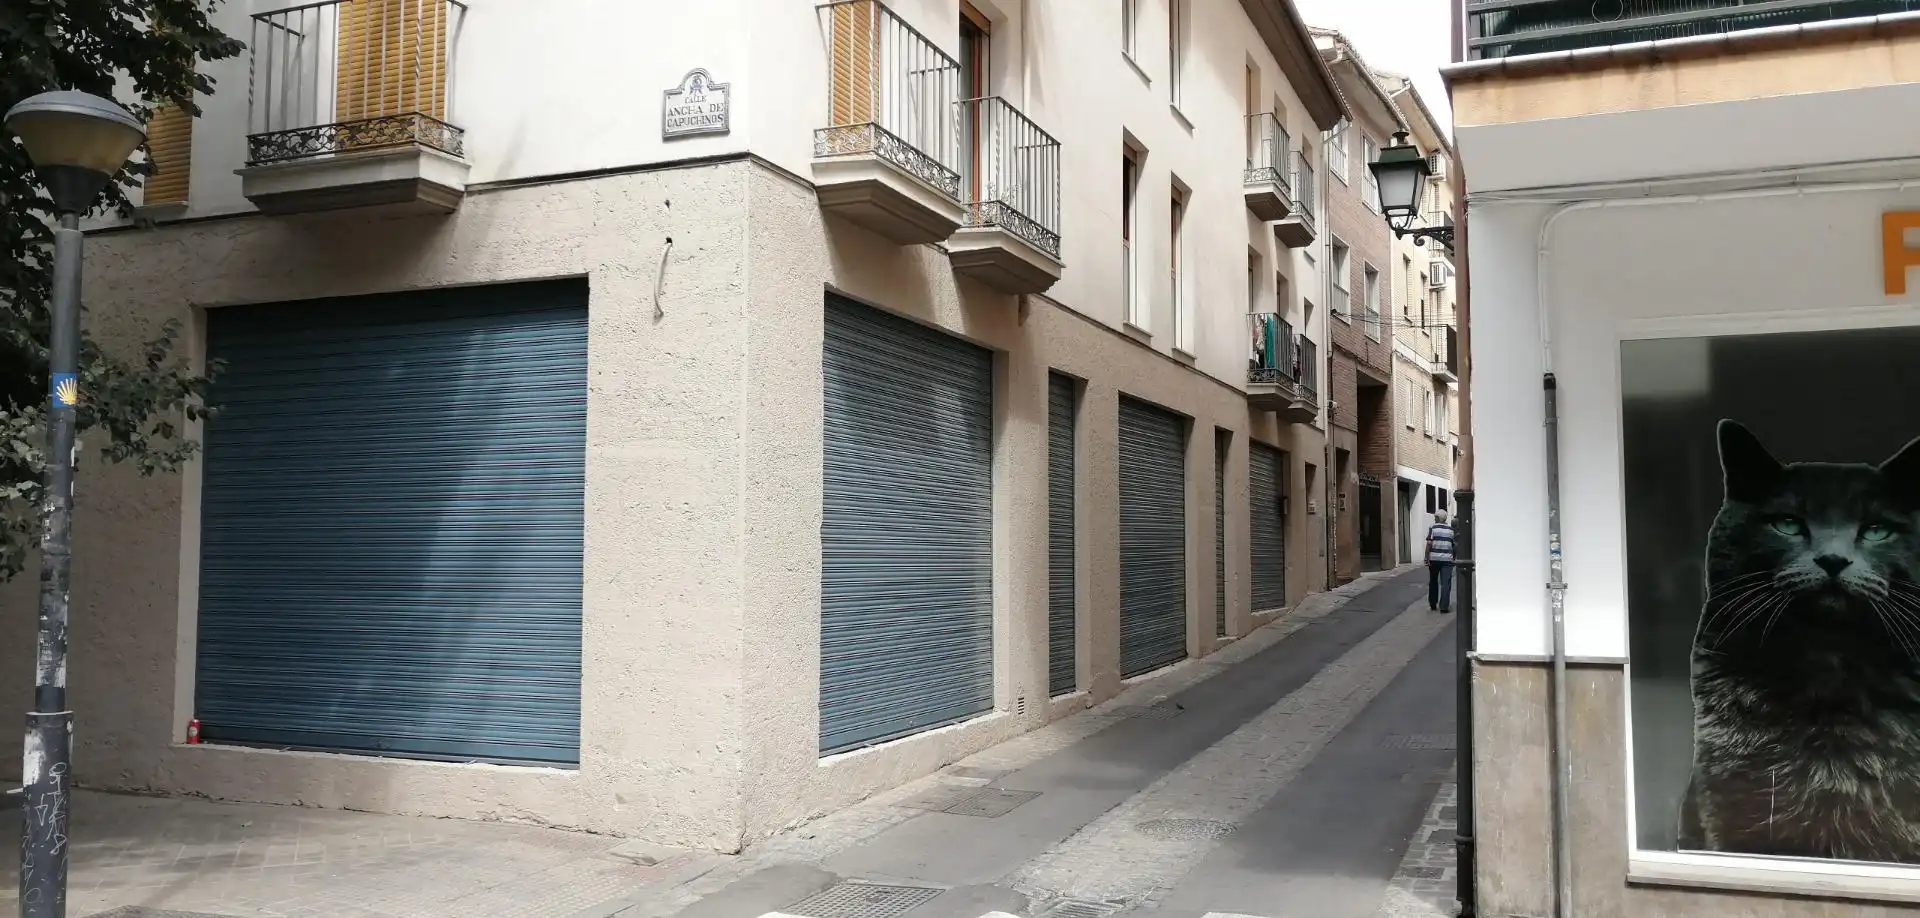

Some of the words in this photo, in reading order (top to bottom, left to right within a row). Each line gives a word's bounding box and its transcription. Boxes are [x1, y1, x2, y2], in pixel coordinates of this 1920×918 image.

[684, 95, 707, 104] CALLE
[667, 105, 704, 117] ANCHA
[709, 102, 724, 113] DE
[667, 113, 725, 128] CAPUCHINOS
